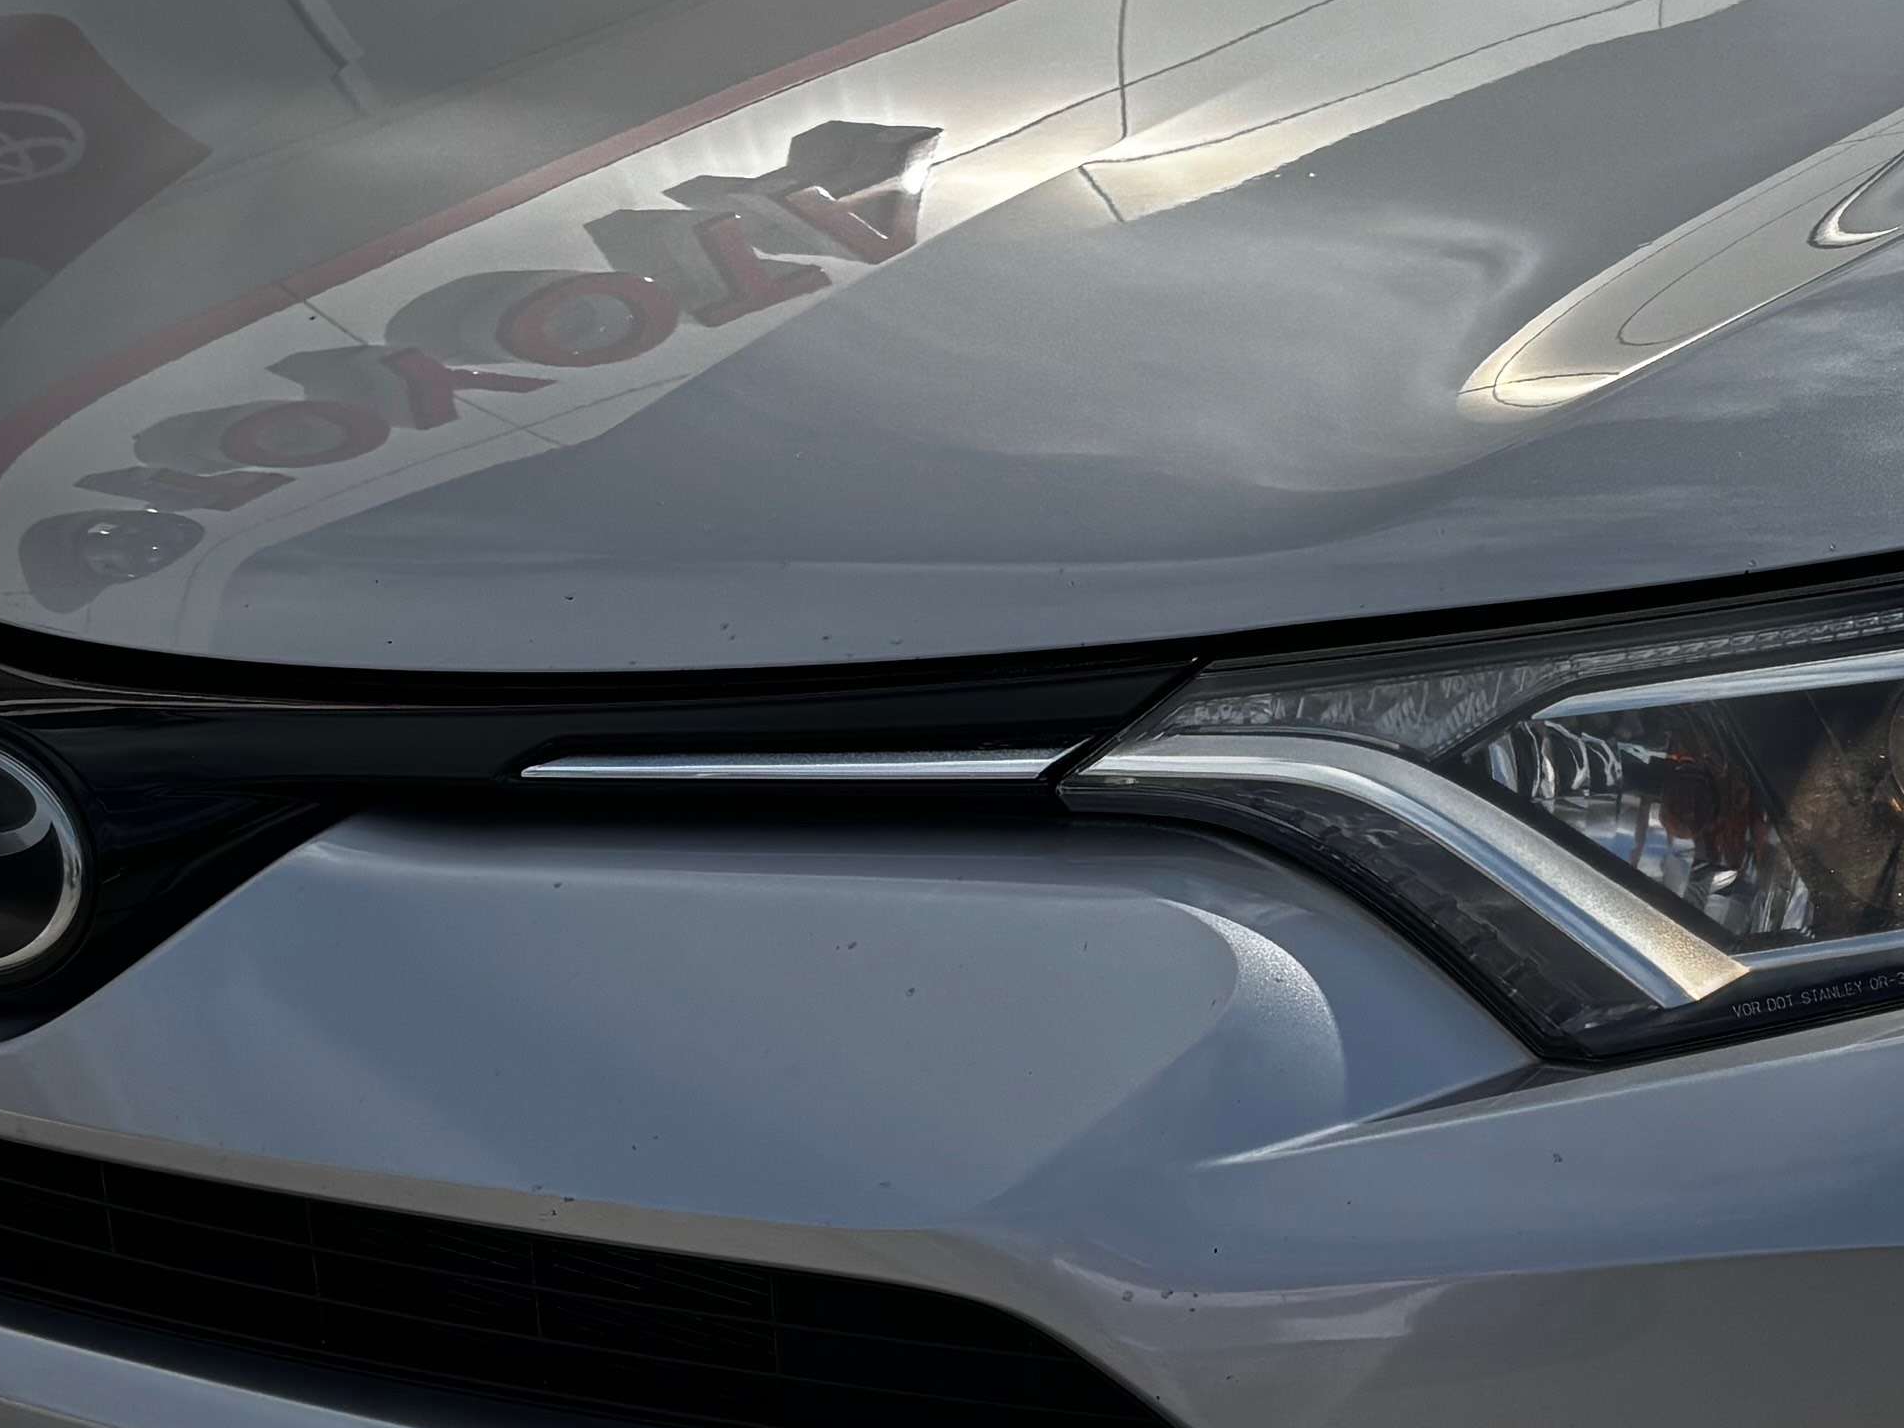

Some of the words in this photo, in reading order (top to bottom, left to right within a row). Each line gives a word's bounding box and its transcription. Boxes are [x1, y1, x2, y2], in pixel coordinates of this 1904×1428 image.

[1732, 1000, 1761, 1018] VOR
[1766, 994, 1793, 1012] DOT
[1800, 980, 1863, 1005] STANLEY
